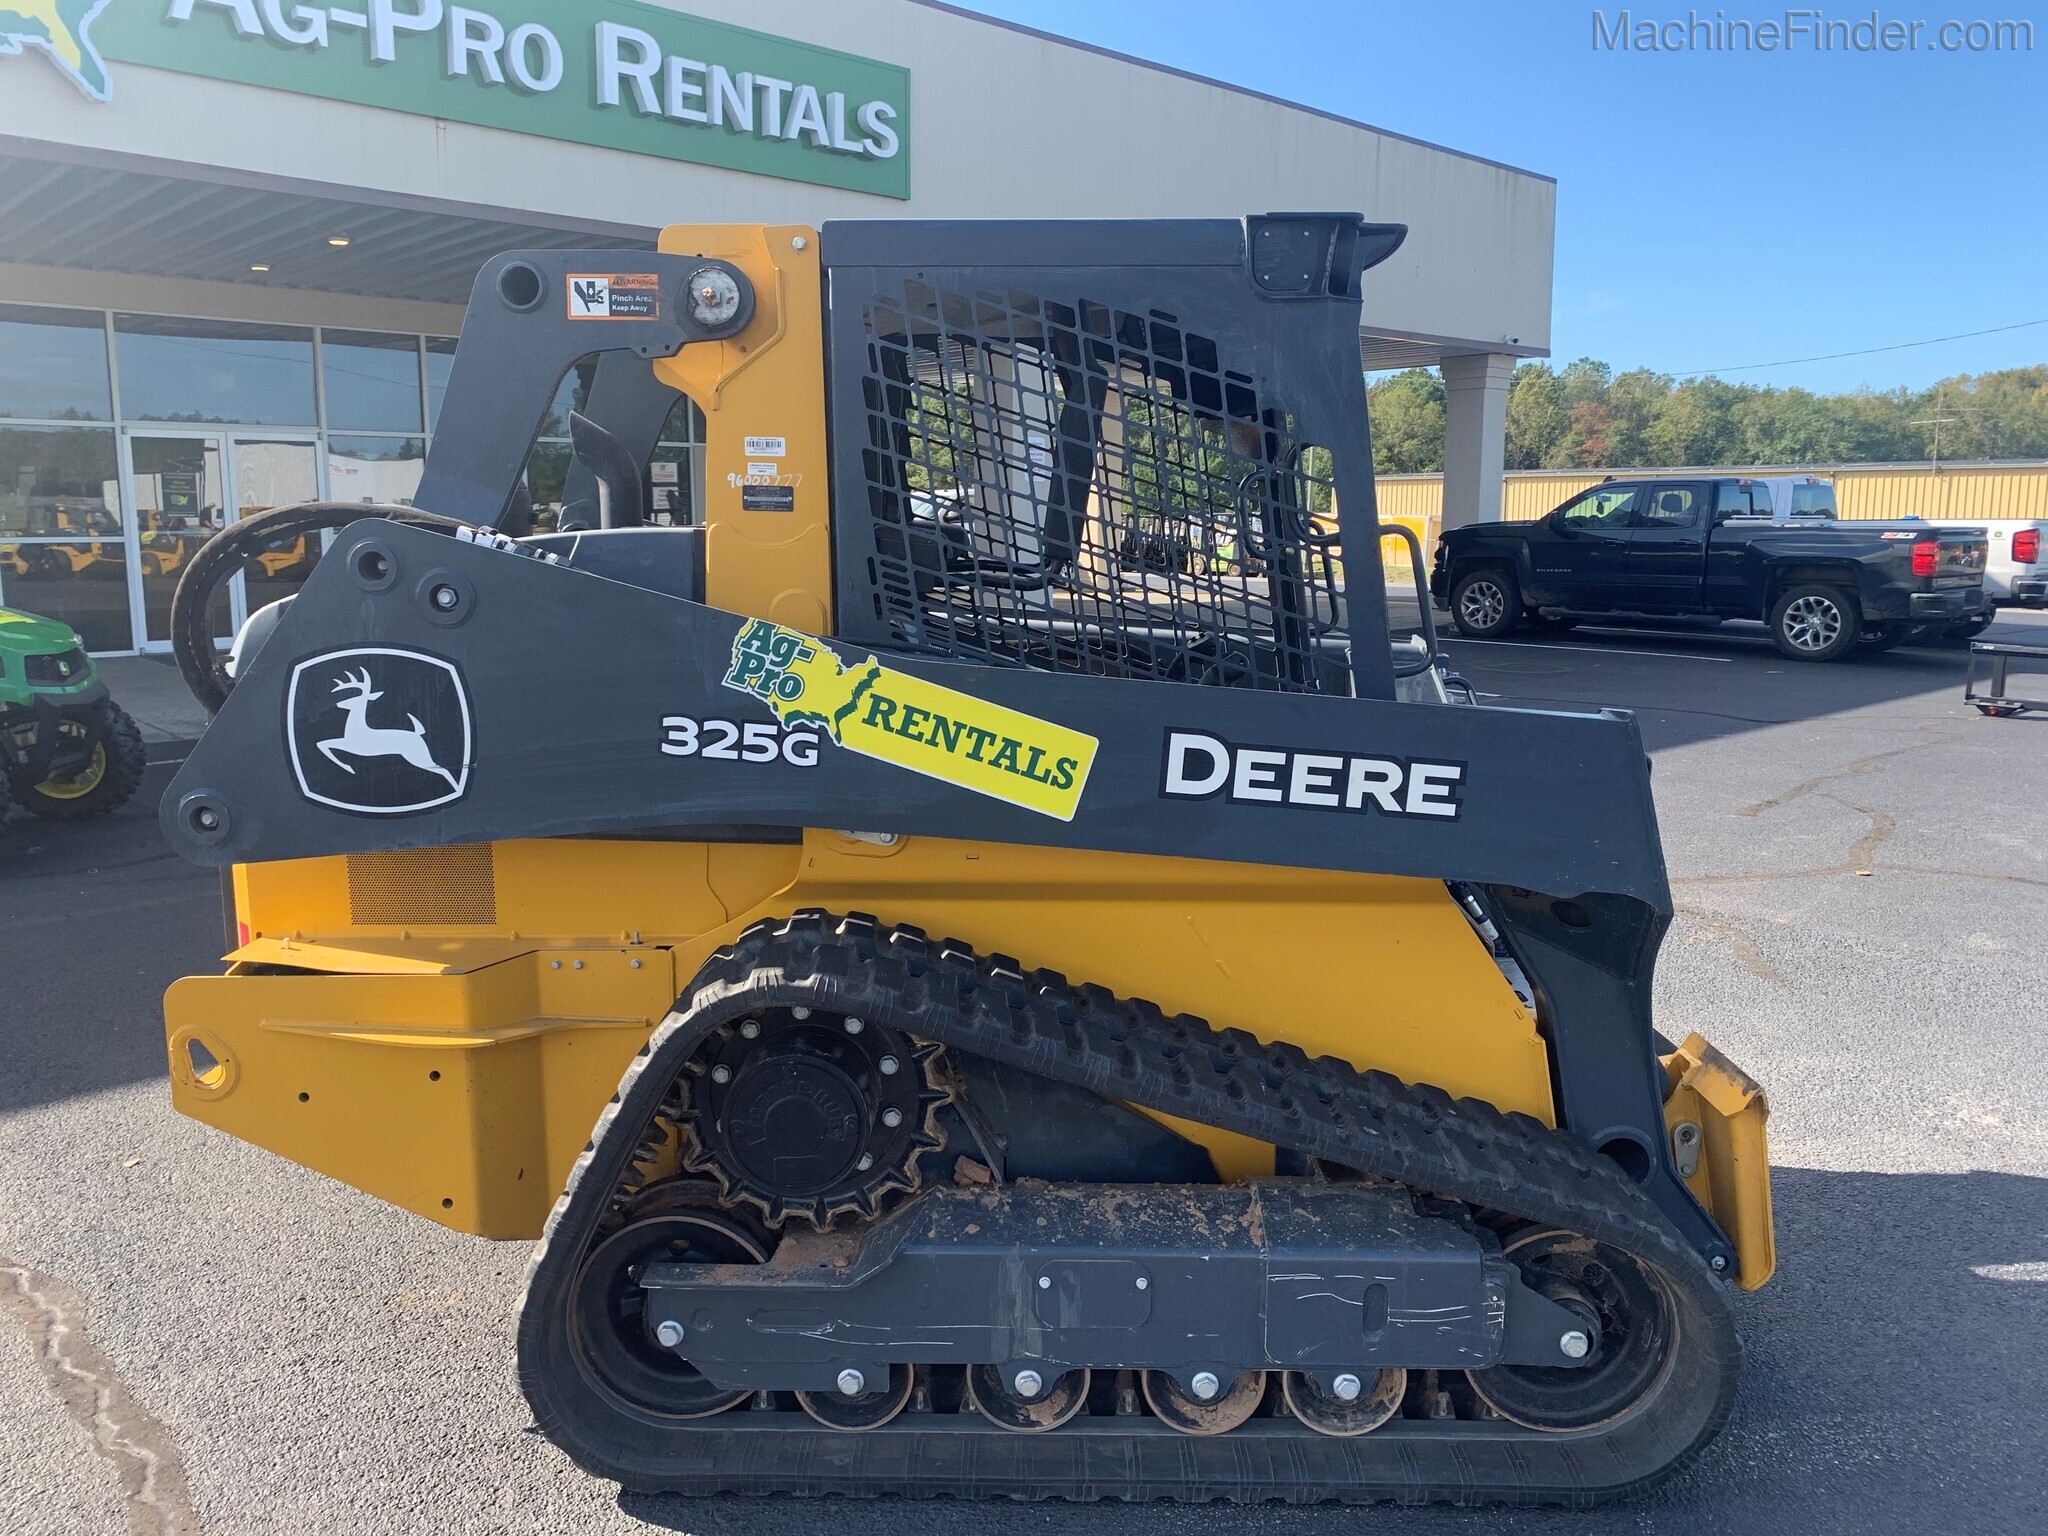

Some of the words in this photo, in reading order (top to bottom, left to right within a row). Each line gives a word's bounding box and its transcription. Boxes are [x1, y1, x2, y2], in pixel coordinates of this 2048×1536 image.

[165, 0, 565, 92] G-PRO
[595, 20, 900, 160] RENTALS
[612, 294, 633, 302] Pinch
[612, 304, 629, 312] Keep
[727, 472, 803, 488] 96000777
[739, 618, 816, 668] Ag-
[726, 649, 804, 702] Pro
[661, 716, 819, 767] 325G
[861, 693, 1079, 791] RENTALS
[1165, 732, 1462, 817] DEERE
